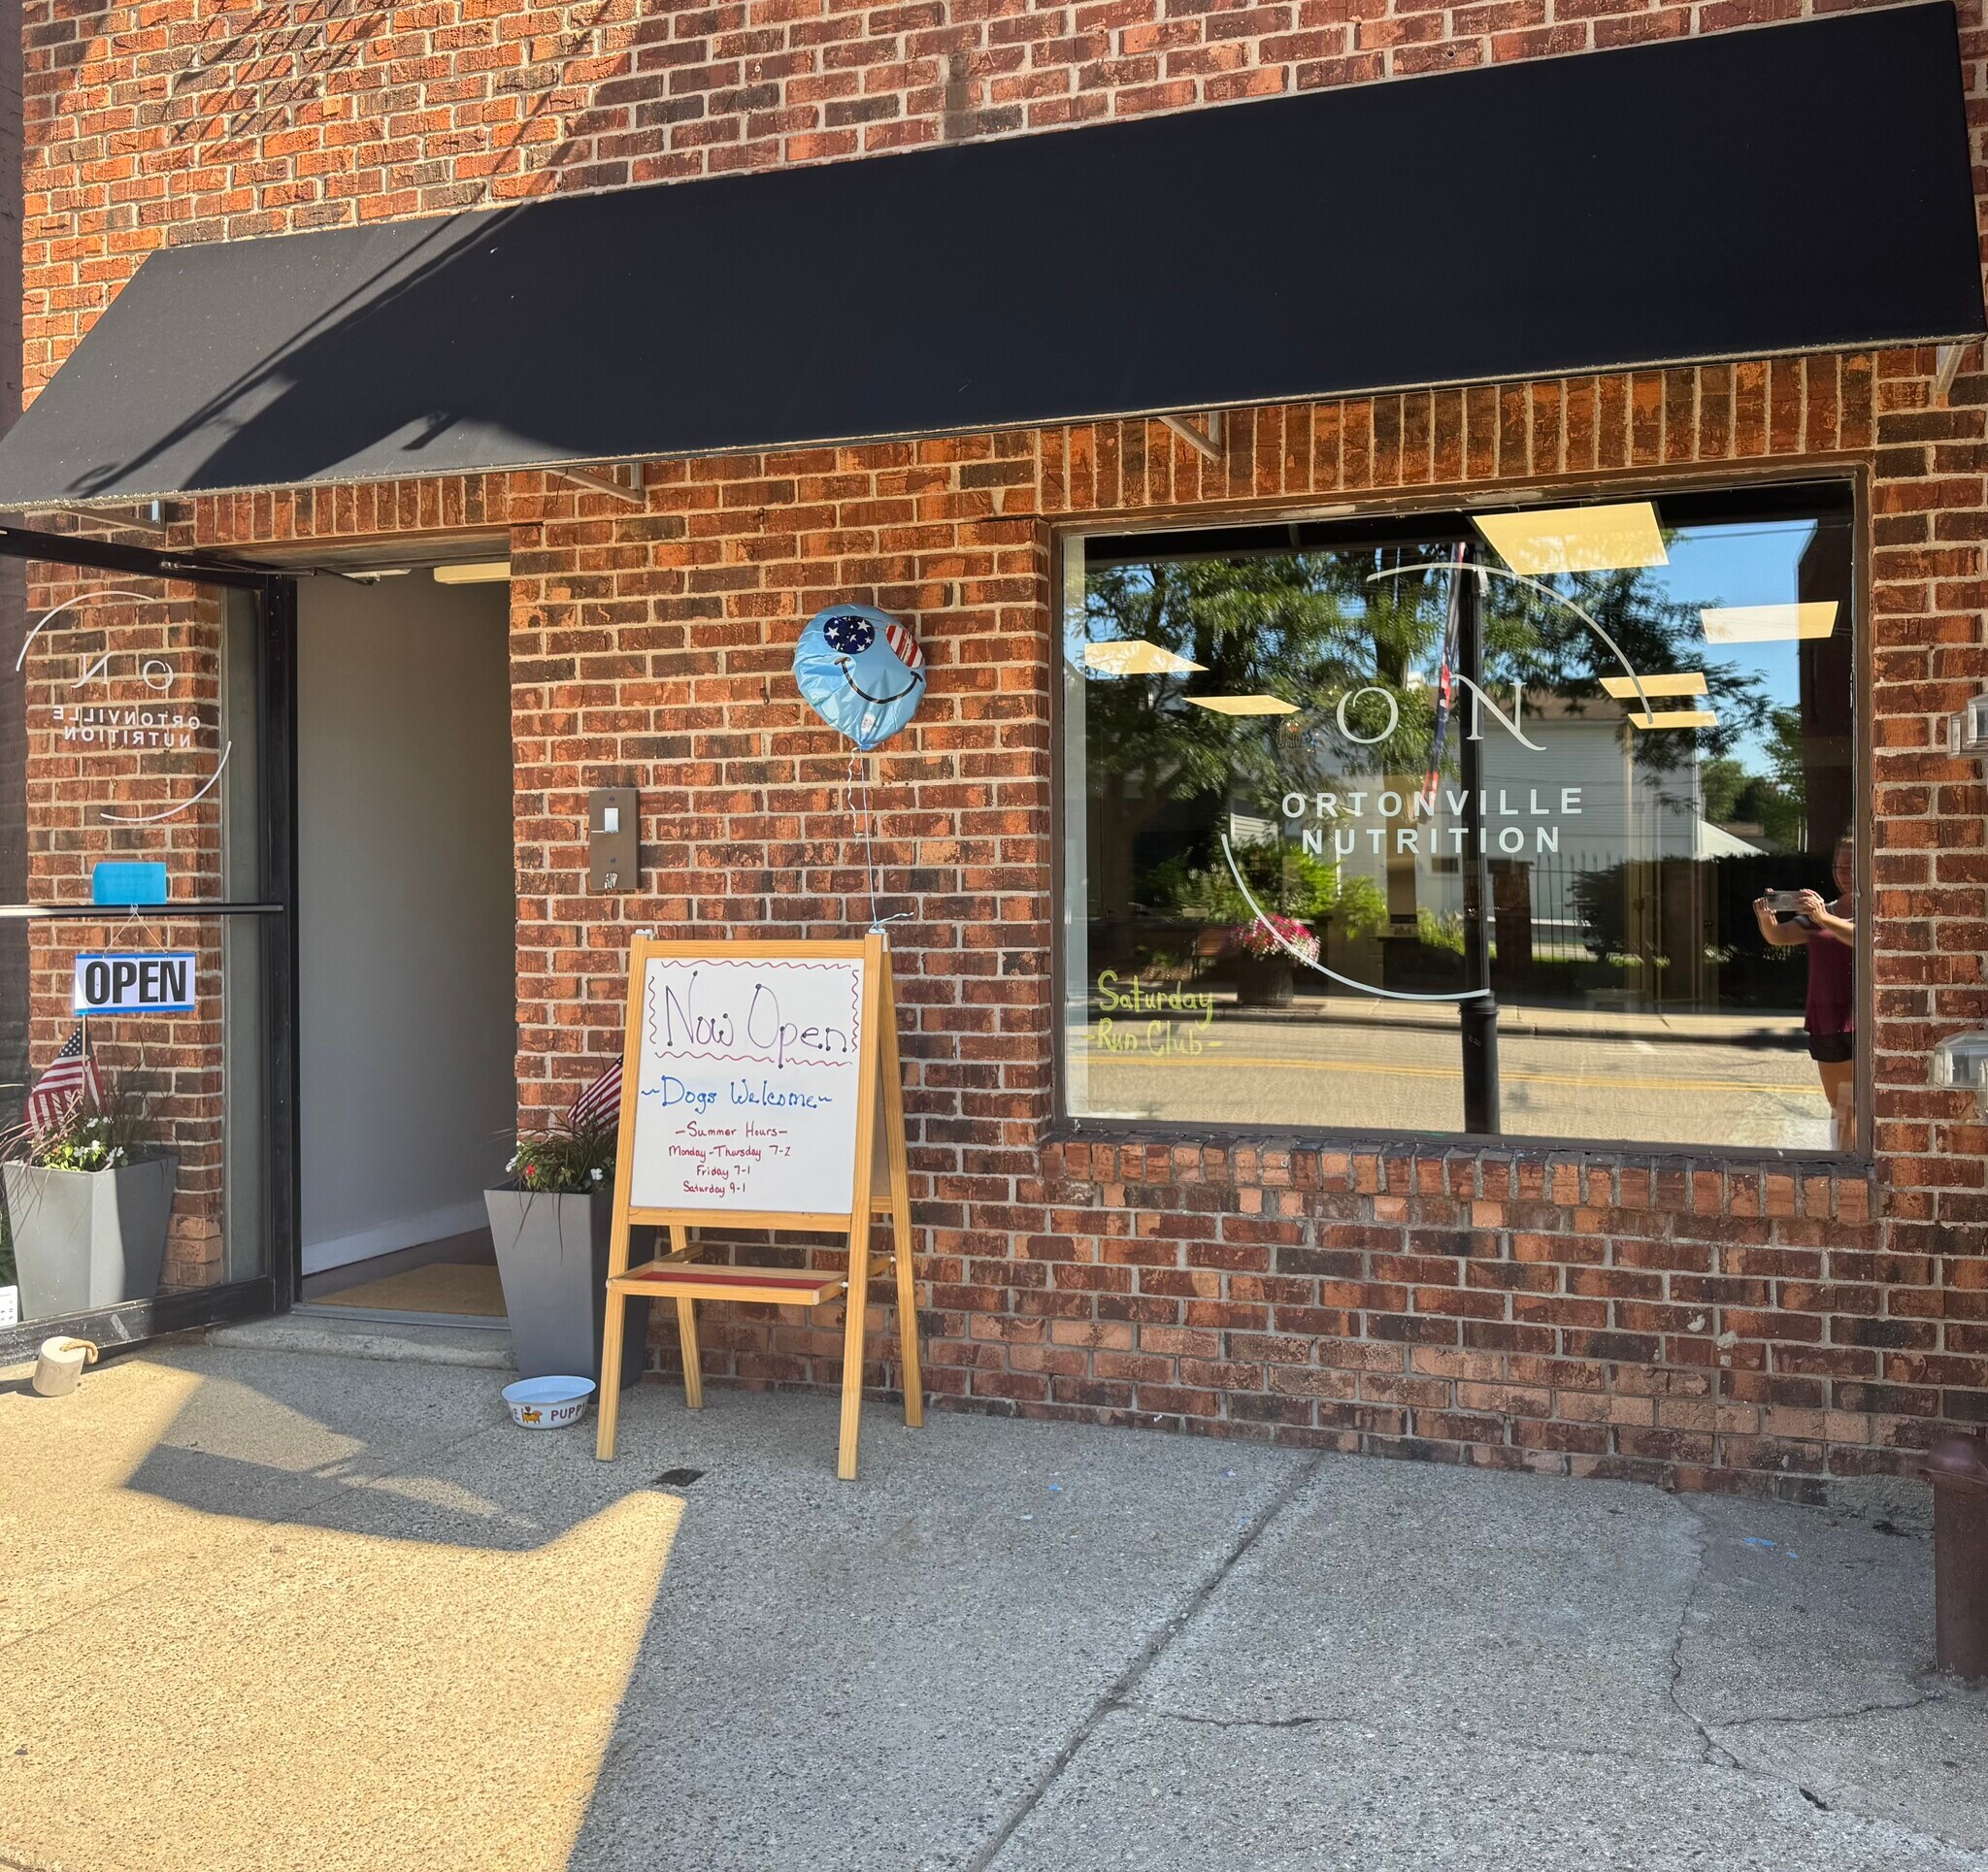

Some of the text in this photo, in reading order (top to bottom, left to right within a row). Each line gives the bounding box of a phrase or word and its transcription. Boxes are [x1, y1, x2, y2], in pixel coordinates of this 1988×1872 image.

[1281, 787, 1582, 818] ORTONVILLE
[1302, 826, 1559, 855] NUTRITION
[85, 960, 186, 1005] OPEN
[1097, 969, 1213, 1032] Saturday
[664, 970, 847, 1069] Now Open
[769, 1144, 792, 1158] 7-2
[696, 1165, 751, 1180] Friday 7-1
[682, 1180, 746, 1199] Saturday 9-1
